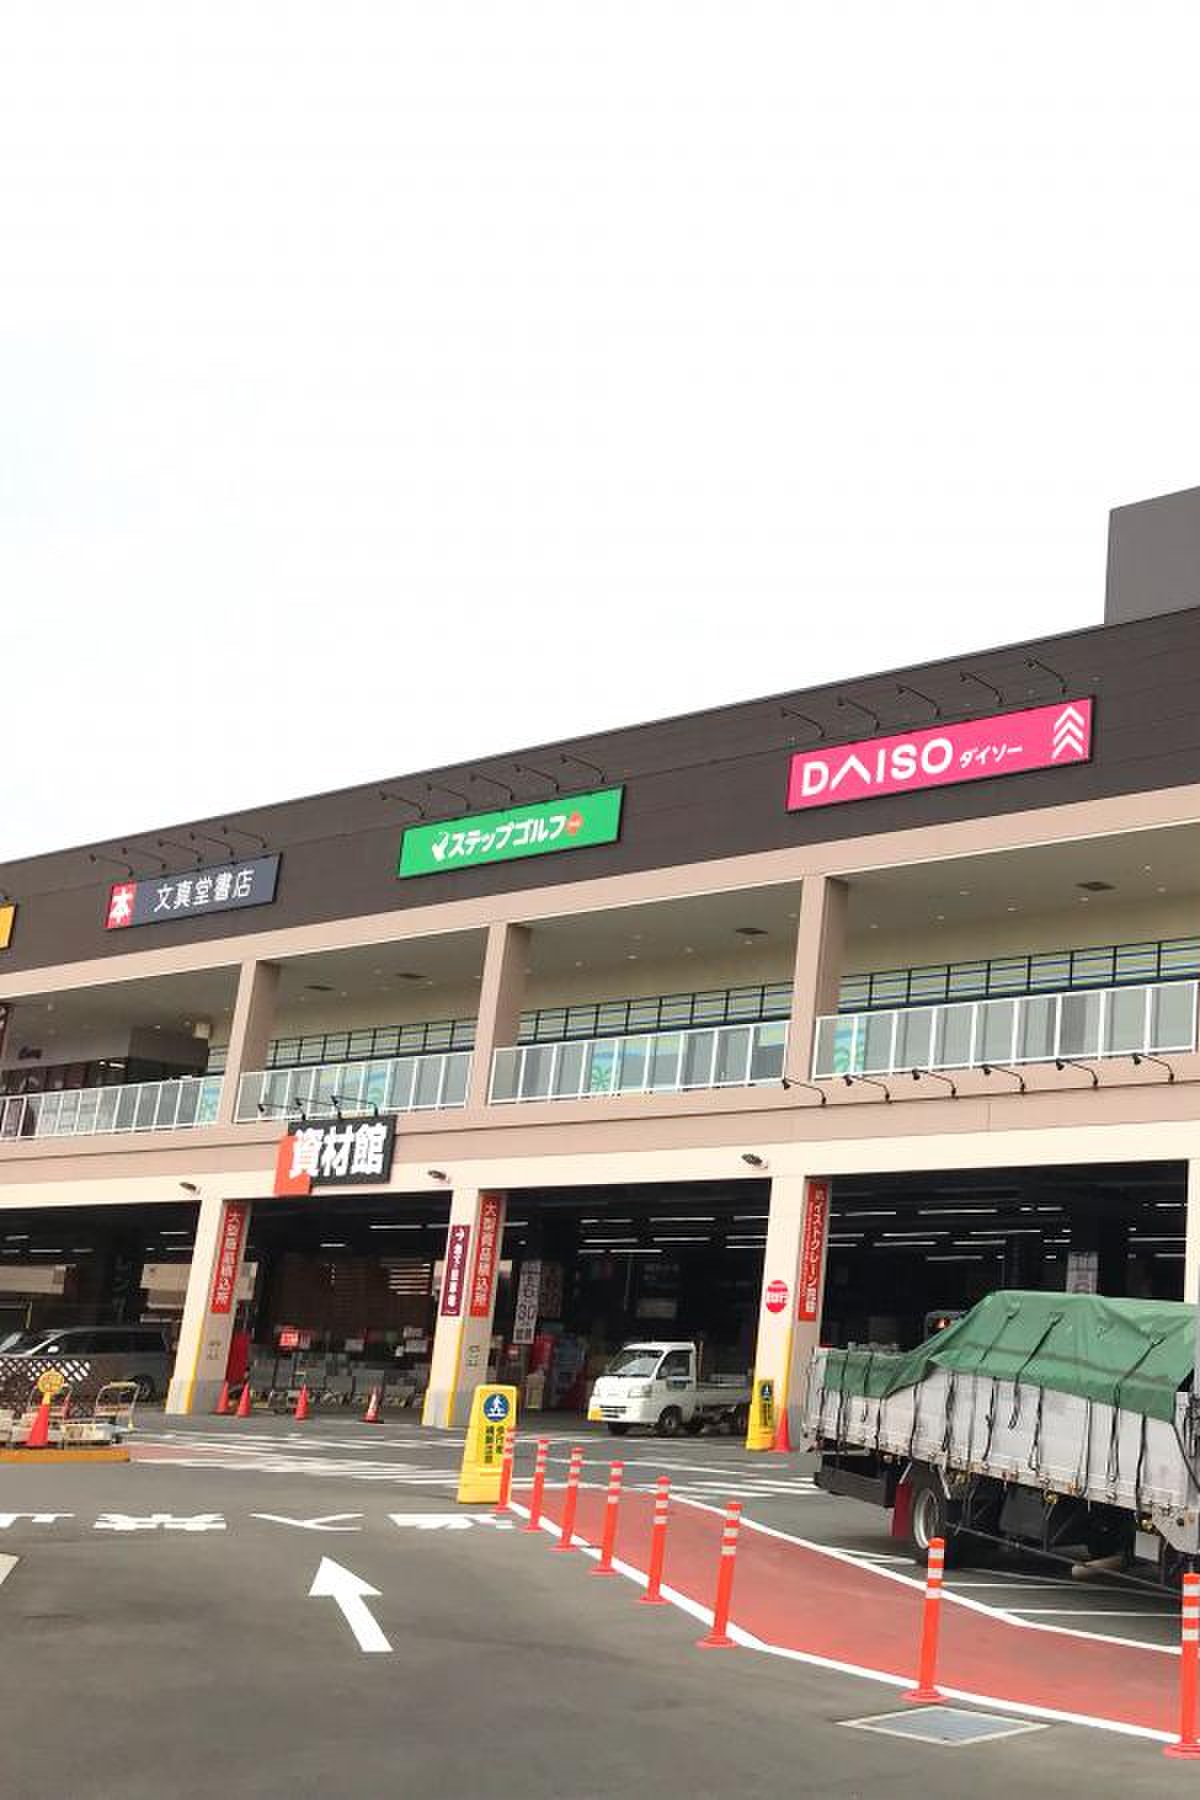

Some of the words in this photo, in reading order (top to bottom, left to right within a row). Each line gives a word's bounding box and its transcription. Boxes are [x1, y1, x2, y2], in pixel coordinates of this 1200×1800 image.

[801, 738, 954, 797] DAISO
[959, 744, 1023, 769] ダイソー
[449, 815, 567, 857] ステップゴルフ
[110, 888, 133, 924] 本
[154, 869, 255, 913] 文真堂書店
[289, 1122, 388, 1180] 資材館
